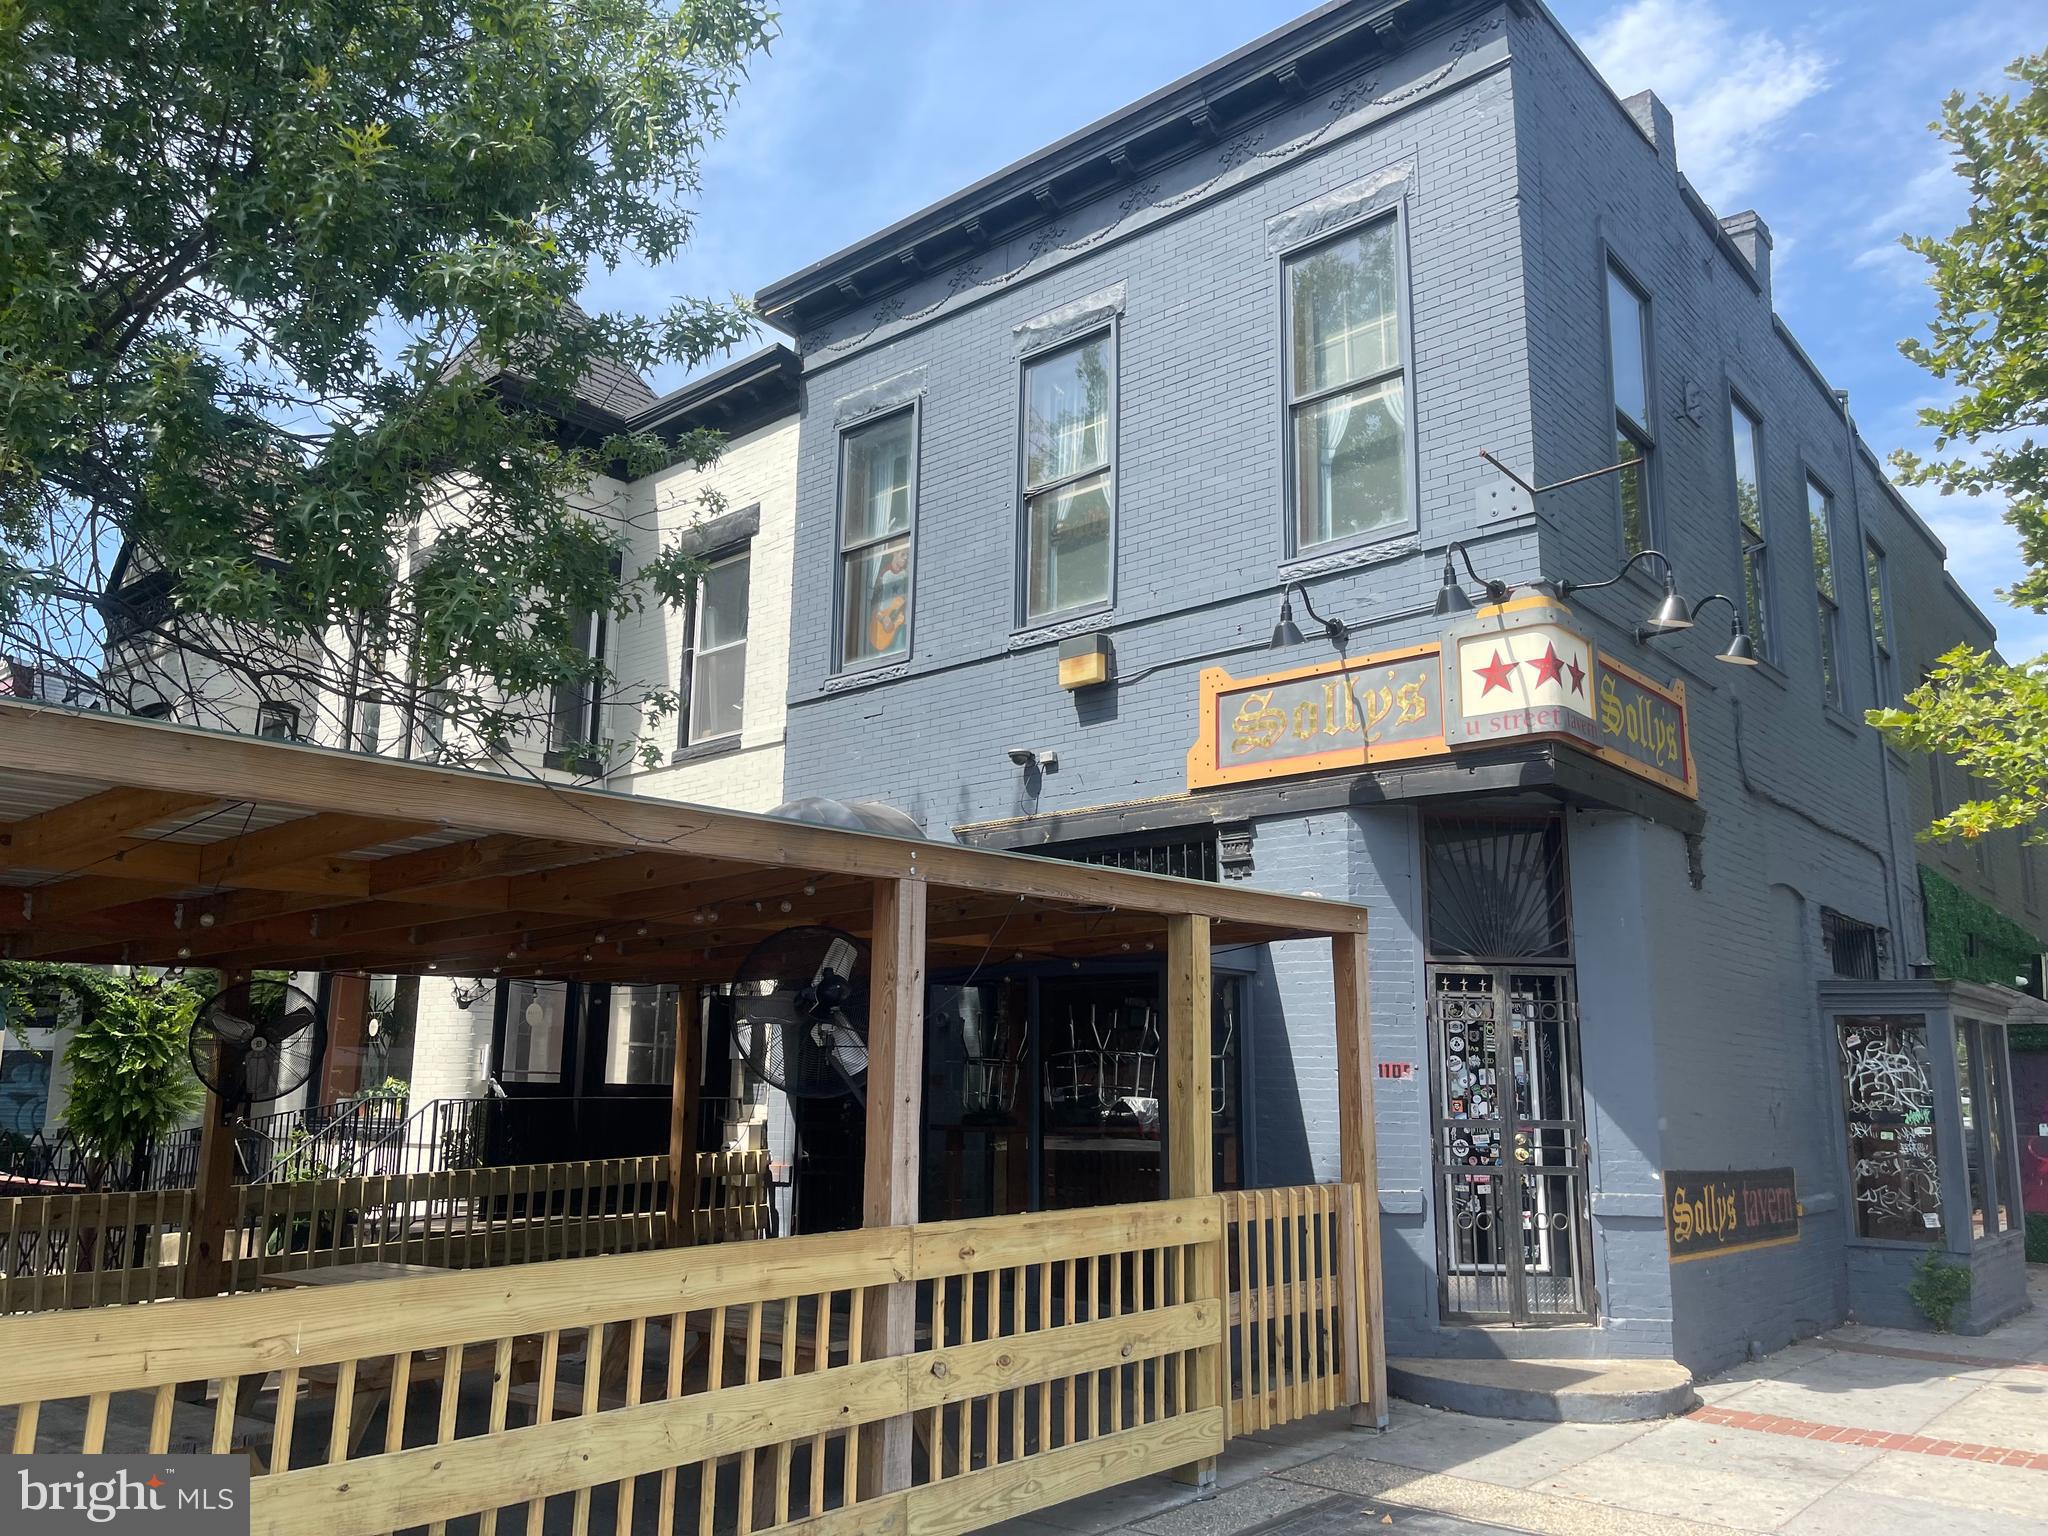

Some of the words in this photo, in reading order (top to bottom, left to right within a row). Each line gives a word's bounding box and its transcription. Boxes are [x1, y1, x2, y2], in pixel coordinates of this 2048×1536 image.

[1232, 670, 1427, 755] Solly's
[1466, 718, 1481, 737] u
[1489, 706, 1561, 733] street
[1566, 710, 1600, 740] tavern
[1600, 673, 1678, 767] Solly's
[1672, 1181, 1737, 1243] Solly's
[1743, 1180, 1793, 1227] tavern
